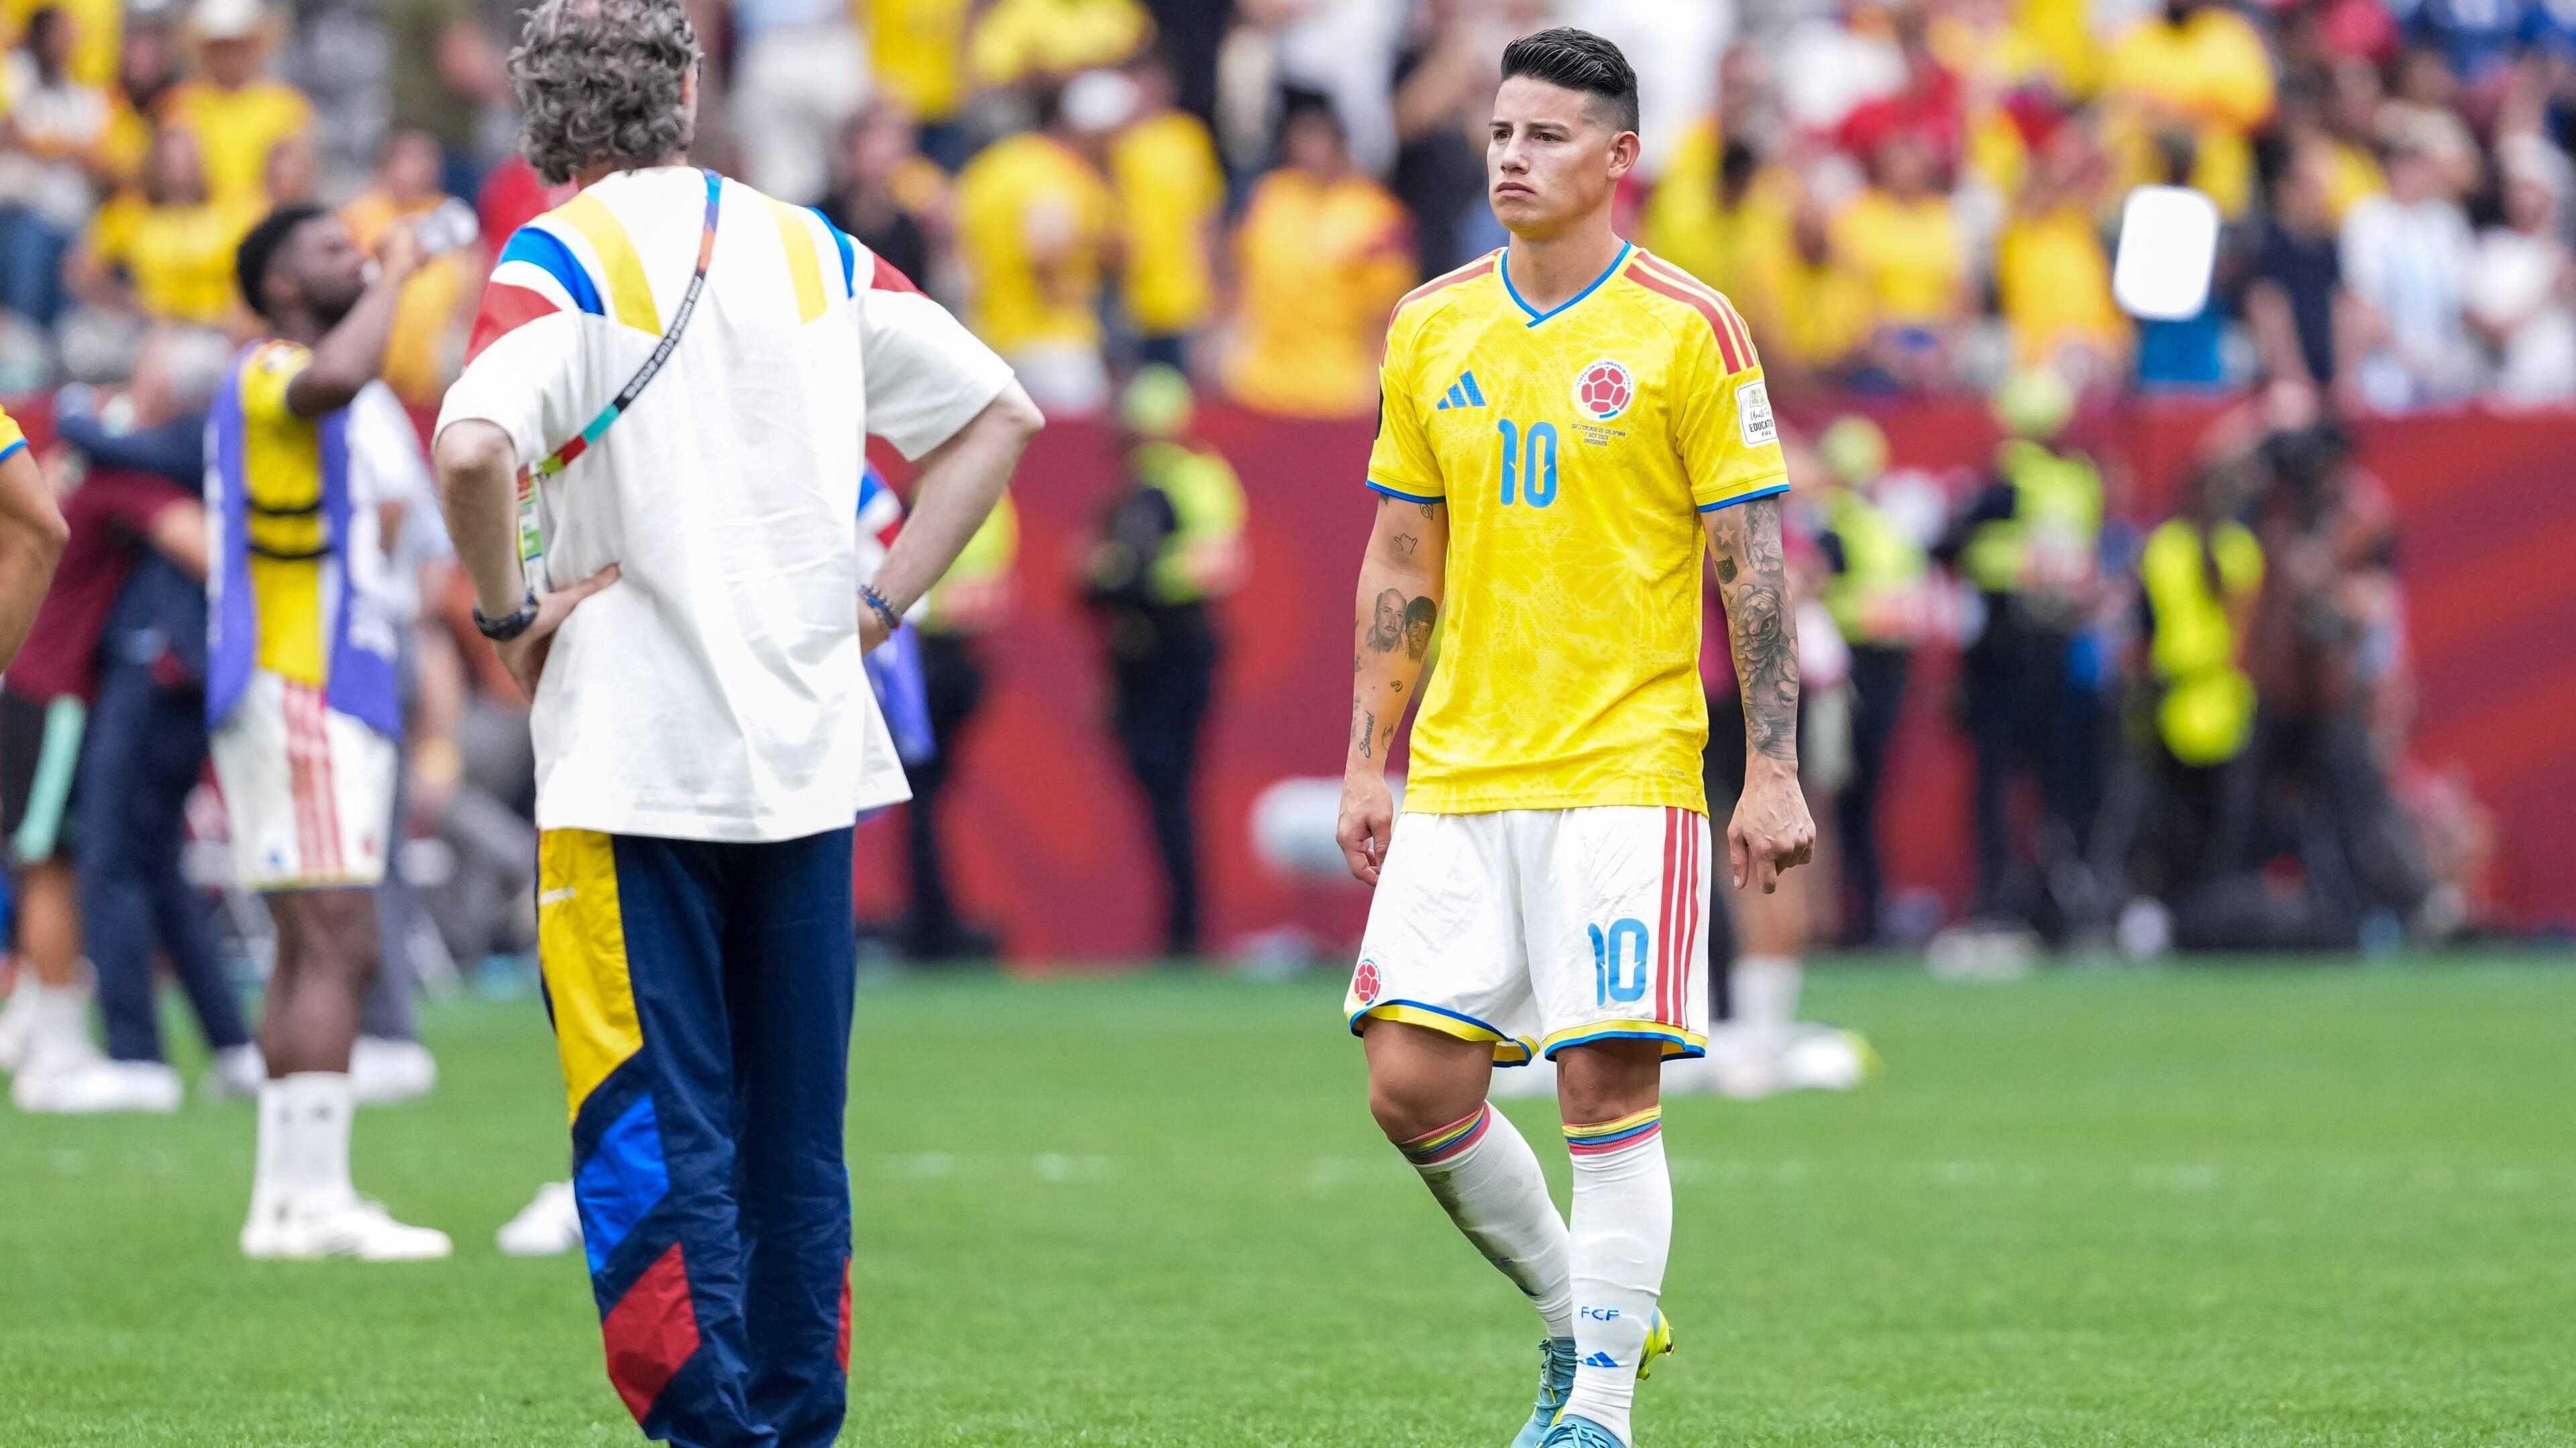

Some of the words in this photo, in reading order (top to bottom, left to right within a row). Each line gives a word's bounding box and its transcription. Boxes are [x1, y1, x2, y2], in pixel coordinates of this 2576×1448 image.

[1497, 419, 1558, 508] 10
[1359, 710, 1375, 759] Samuel
[1588, 918, 1649, 1005] 10
[1581, 1306, 1619, 1321] FCF
